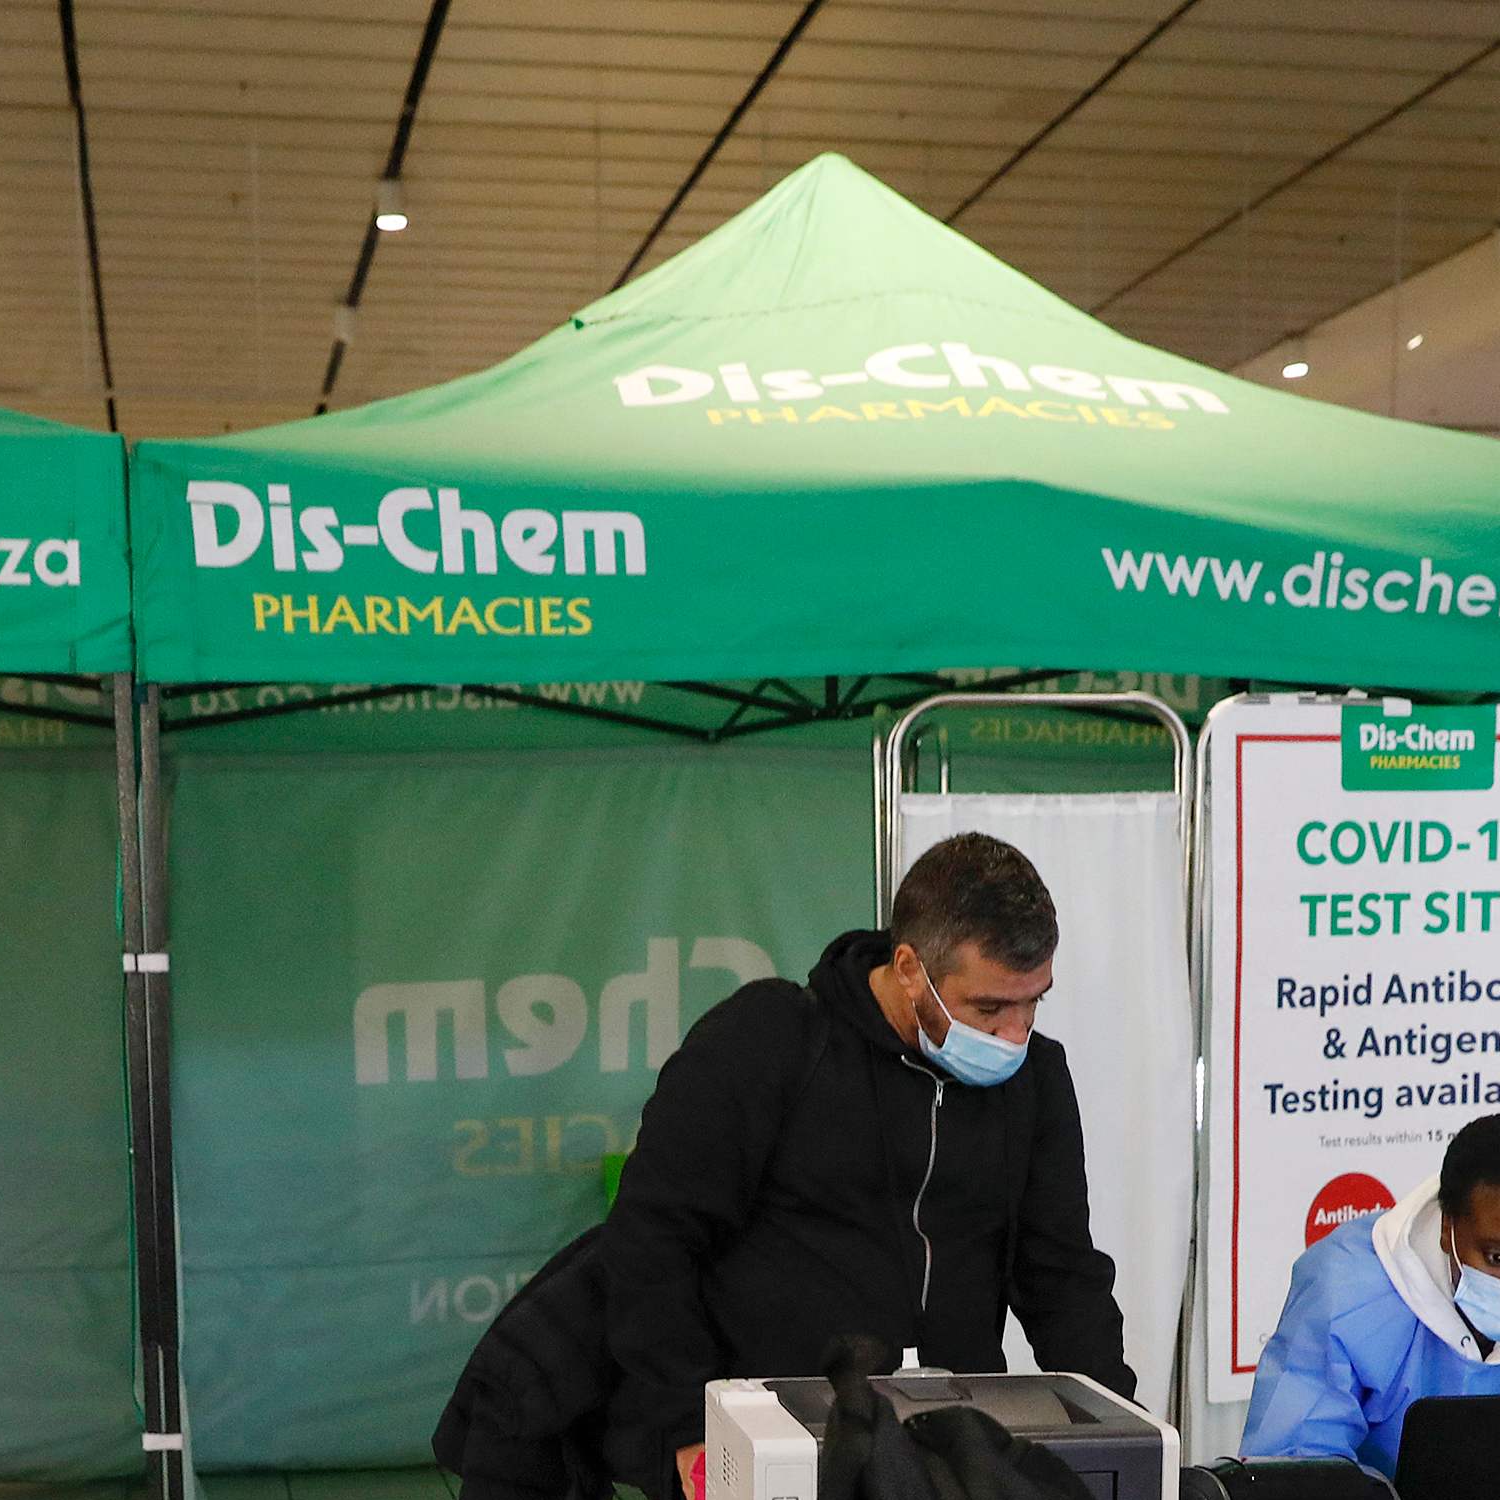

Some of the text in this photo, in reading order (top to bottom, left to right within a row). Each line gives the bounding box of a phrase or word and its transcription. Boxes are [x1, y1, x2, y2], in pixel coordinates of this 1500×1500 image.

[614, 342, 1229, 413] Dis-Chem
[706, 396, 1175, 430] PHARMACIES
[186, 480, 647, 575] Dis-Chem
[253, 592, 591, 635] PHARMACIES
[1359, 724, 1475, 752] Dis-Chem
[1370, 754, 1461, 770] PHARMACIES
[1300, 893, 1410, 936] TEST
[1277, 973, 1372, 1015] Rapid
[1323, 1030, 1347, 1058] &
[1264, 1082, 1384, 1118] Testing
[1319, 1135, 1341, 1147] Test
[1344, 1132, 1381, 1146] results
[1385, 1130, 1421, 1144] within
[1427, 1129, 1442, 1141] 15
